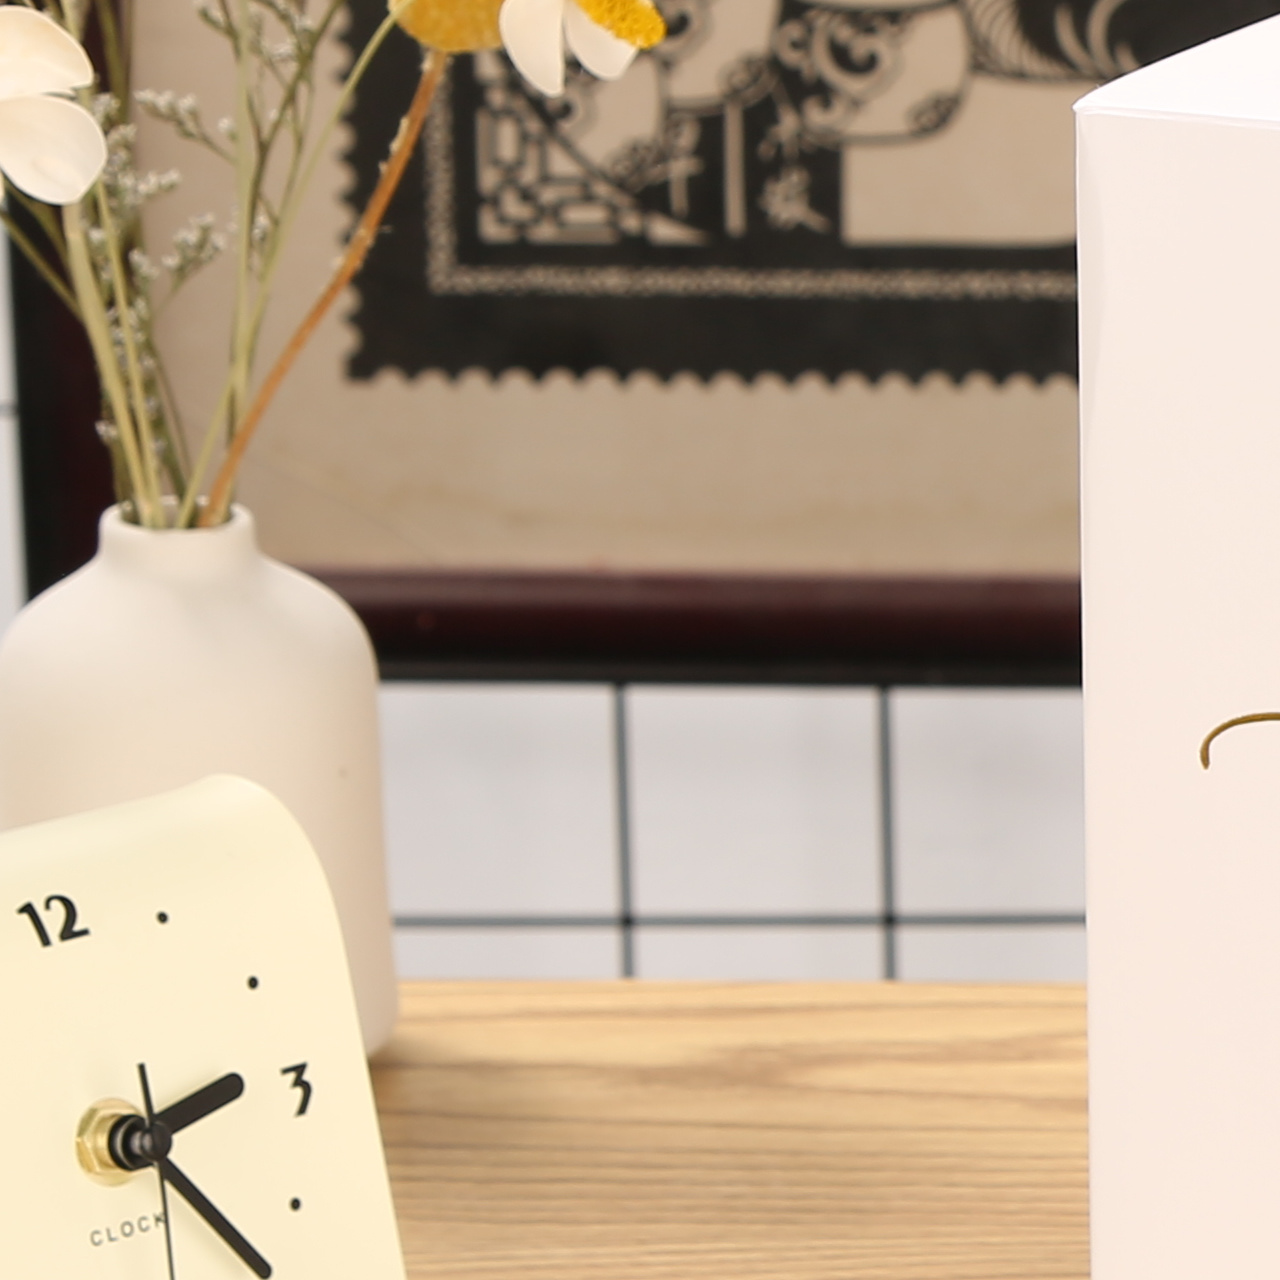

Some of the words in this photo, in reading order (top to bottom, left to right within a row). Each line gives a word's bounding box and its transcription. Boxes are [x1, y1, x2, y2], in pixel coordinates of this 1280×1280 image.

[16, 894, 90, 948] 12
[280, 1061, 313, 1118] 3
[90, 1211, 170, 1247] CLOCK
